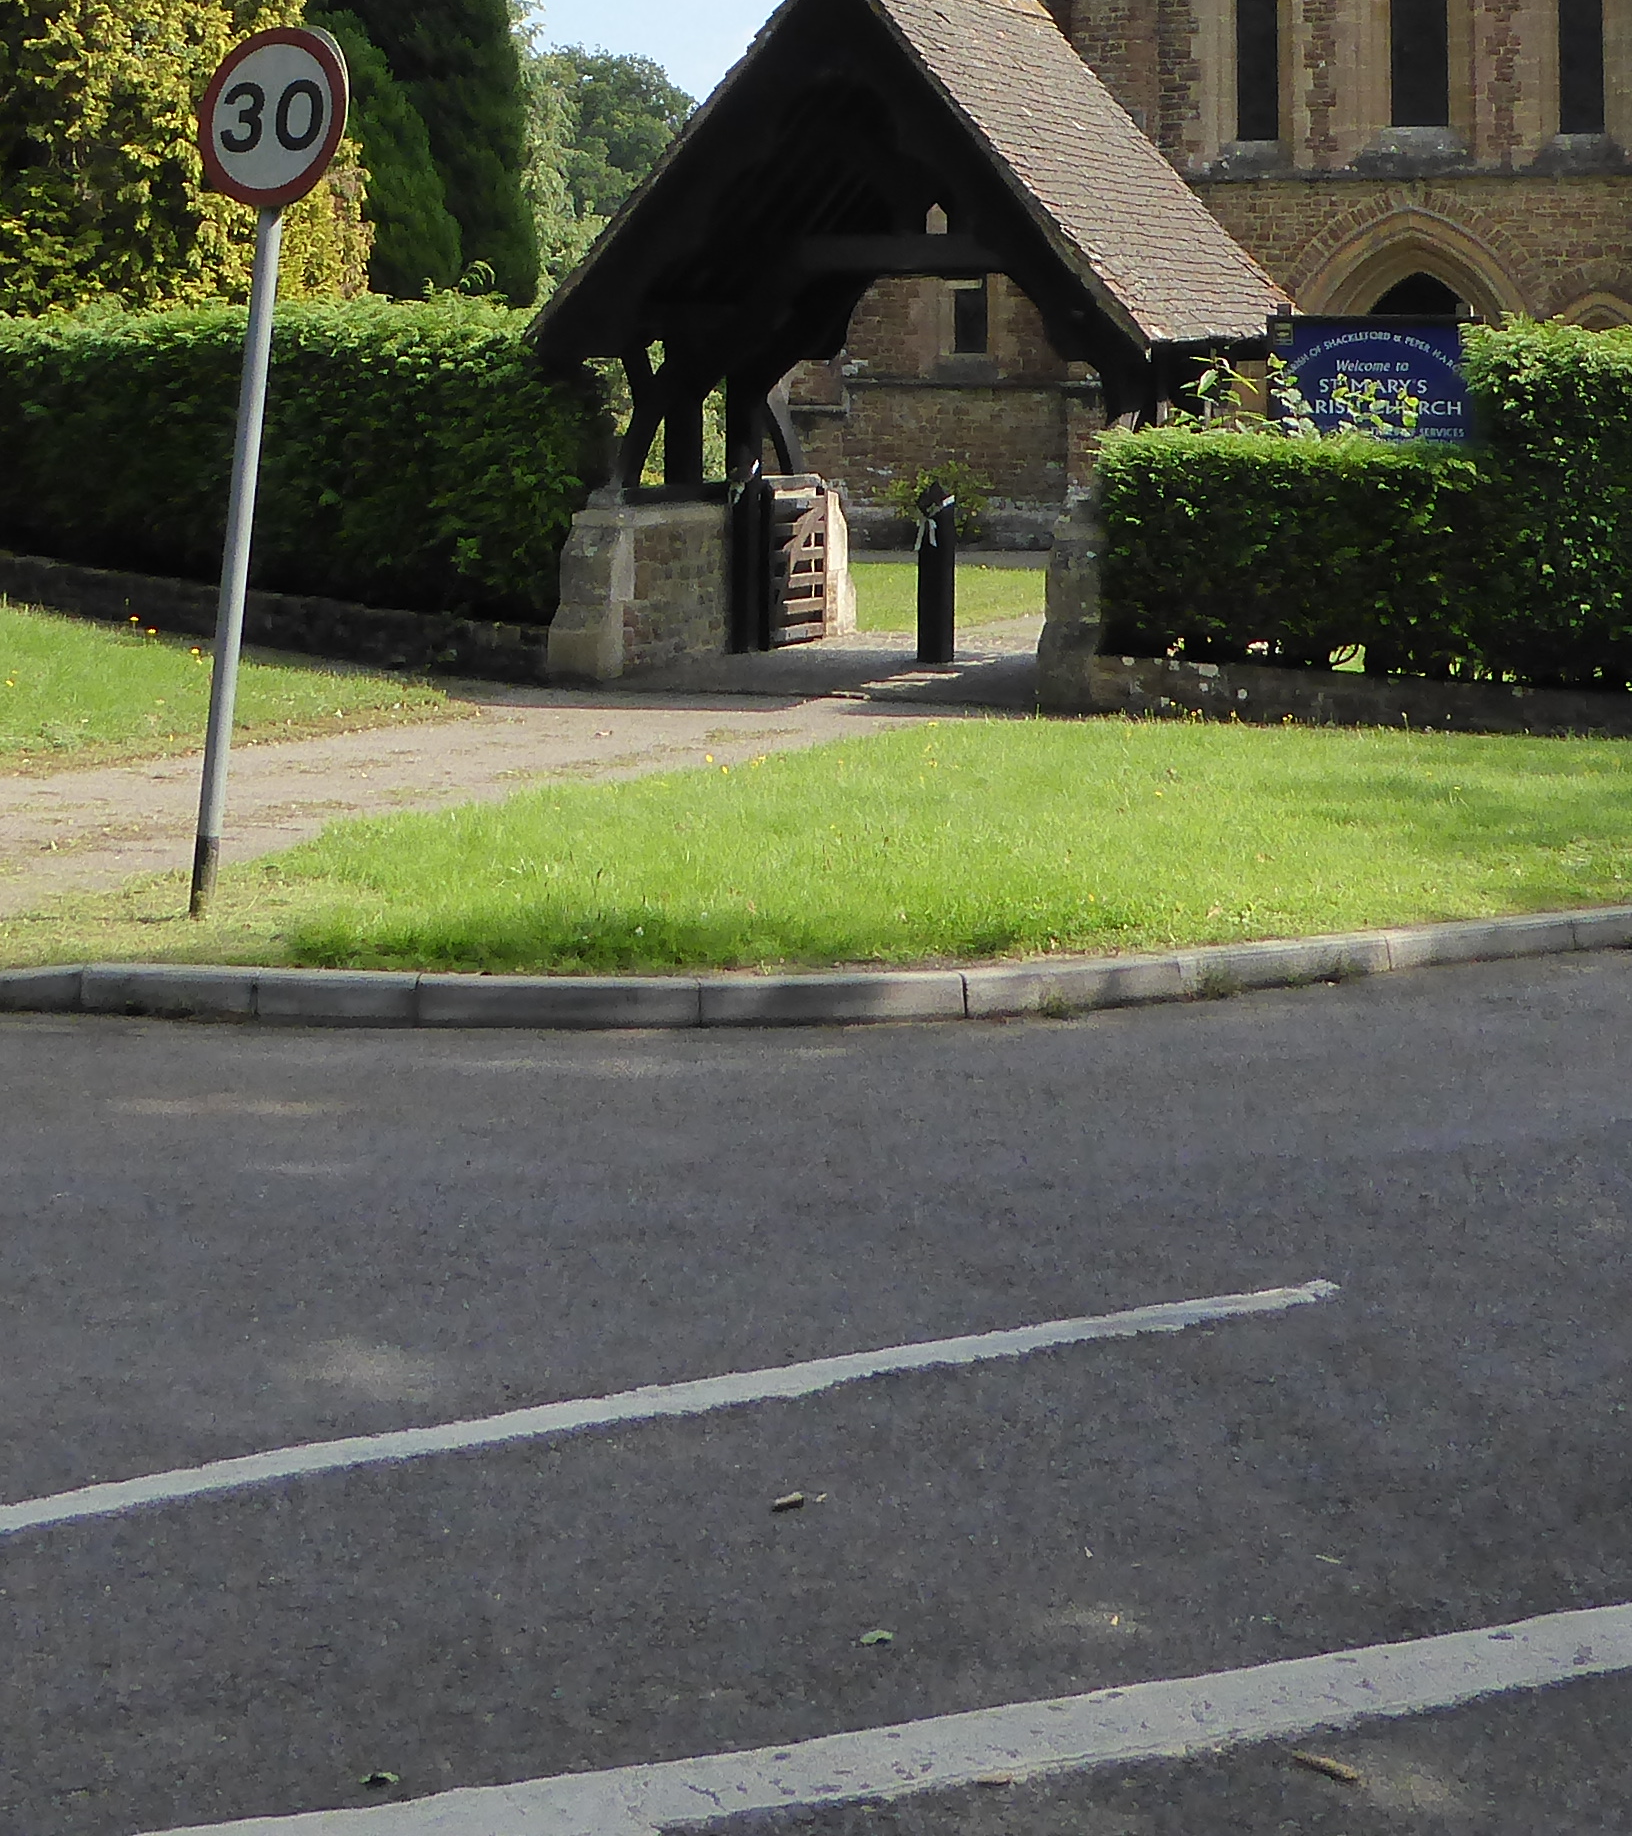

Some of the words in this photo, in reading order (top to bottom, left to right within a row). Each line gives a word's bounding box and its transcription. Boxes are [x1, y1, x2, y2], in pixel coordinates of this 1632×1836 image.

[220, 79, 324, 153] 30
[1285, 354, 1309, 376] ARISH
[1309, 345, 1322, 357] OF
[1323, 331, 1391, 350] SHACKLEFORD
[1393, 334, 1402, 342] &
[1405, 336, 1430, 353] PEPER
[1336, 359, 1391, 372] Welcome
[1395, 362, 1409, 372] to
[1350, 378, 1428, 394] MARY'S
[1419, 427, 1465, 437] SERVICES
